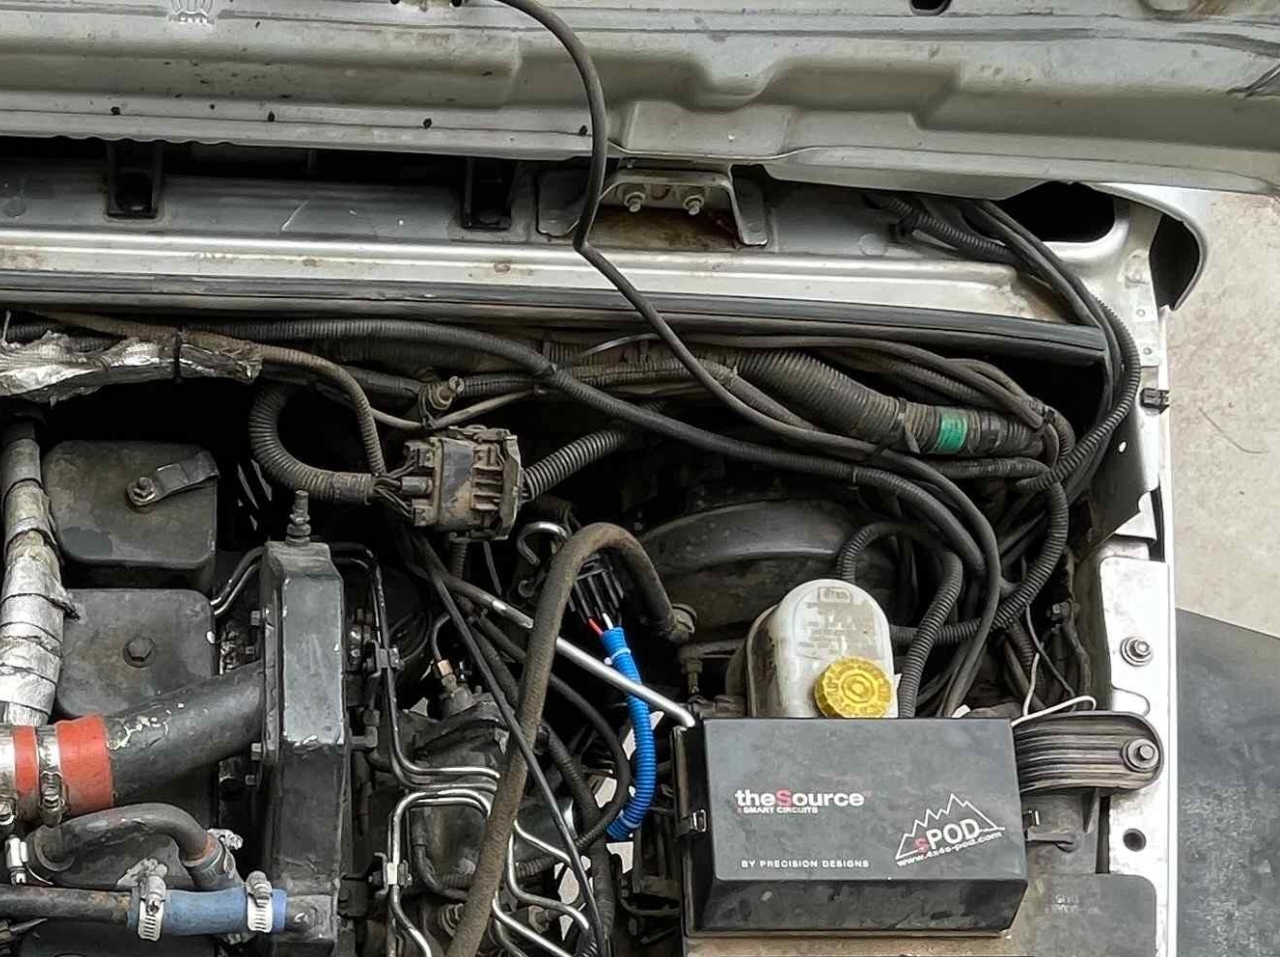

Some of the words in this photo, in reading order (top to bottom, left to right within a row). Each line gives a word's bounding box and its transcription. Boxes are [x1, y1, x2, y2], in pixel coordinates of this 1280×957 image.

[735, 788, 865, 807] theSource
[743, 806, 775, 814] SMART
[776, 806, 819, 814] CIRCUITS
[741, 860, 756, 868] BY
[760, 860, 818, 868] PRECISION
[822, 860, 870, 868] DESIGNS
